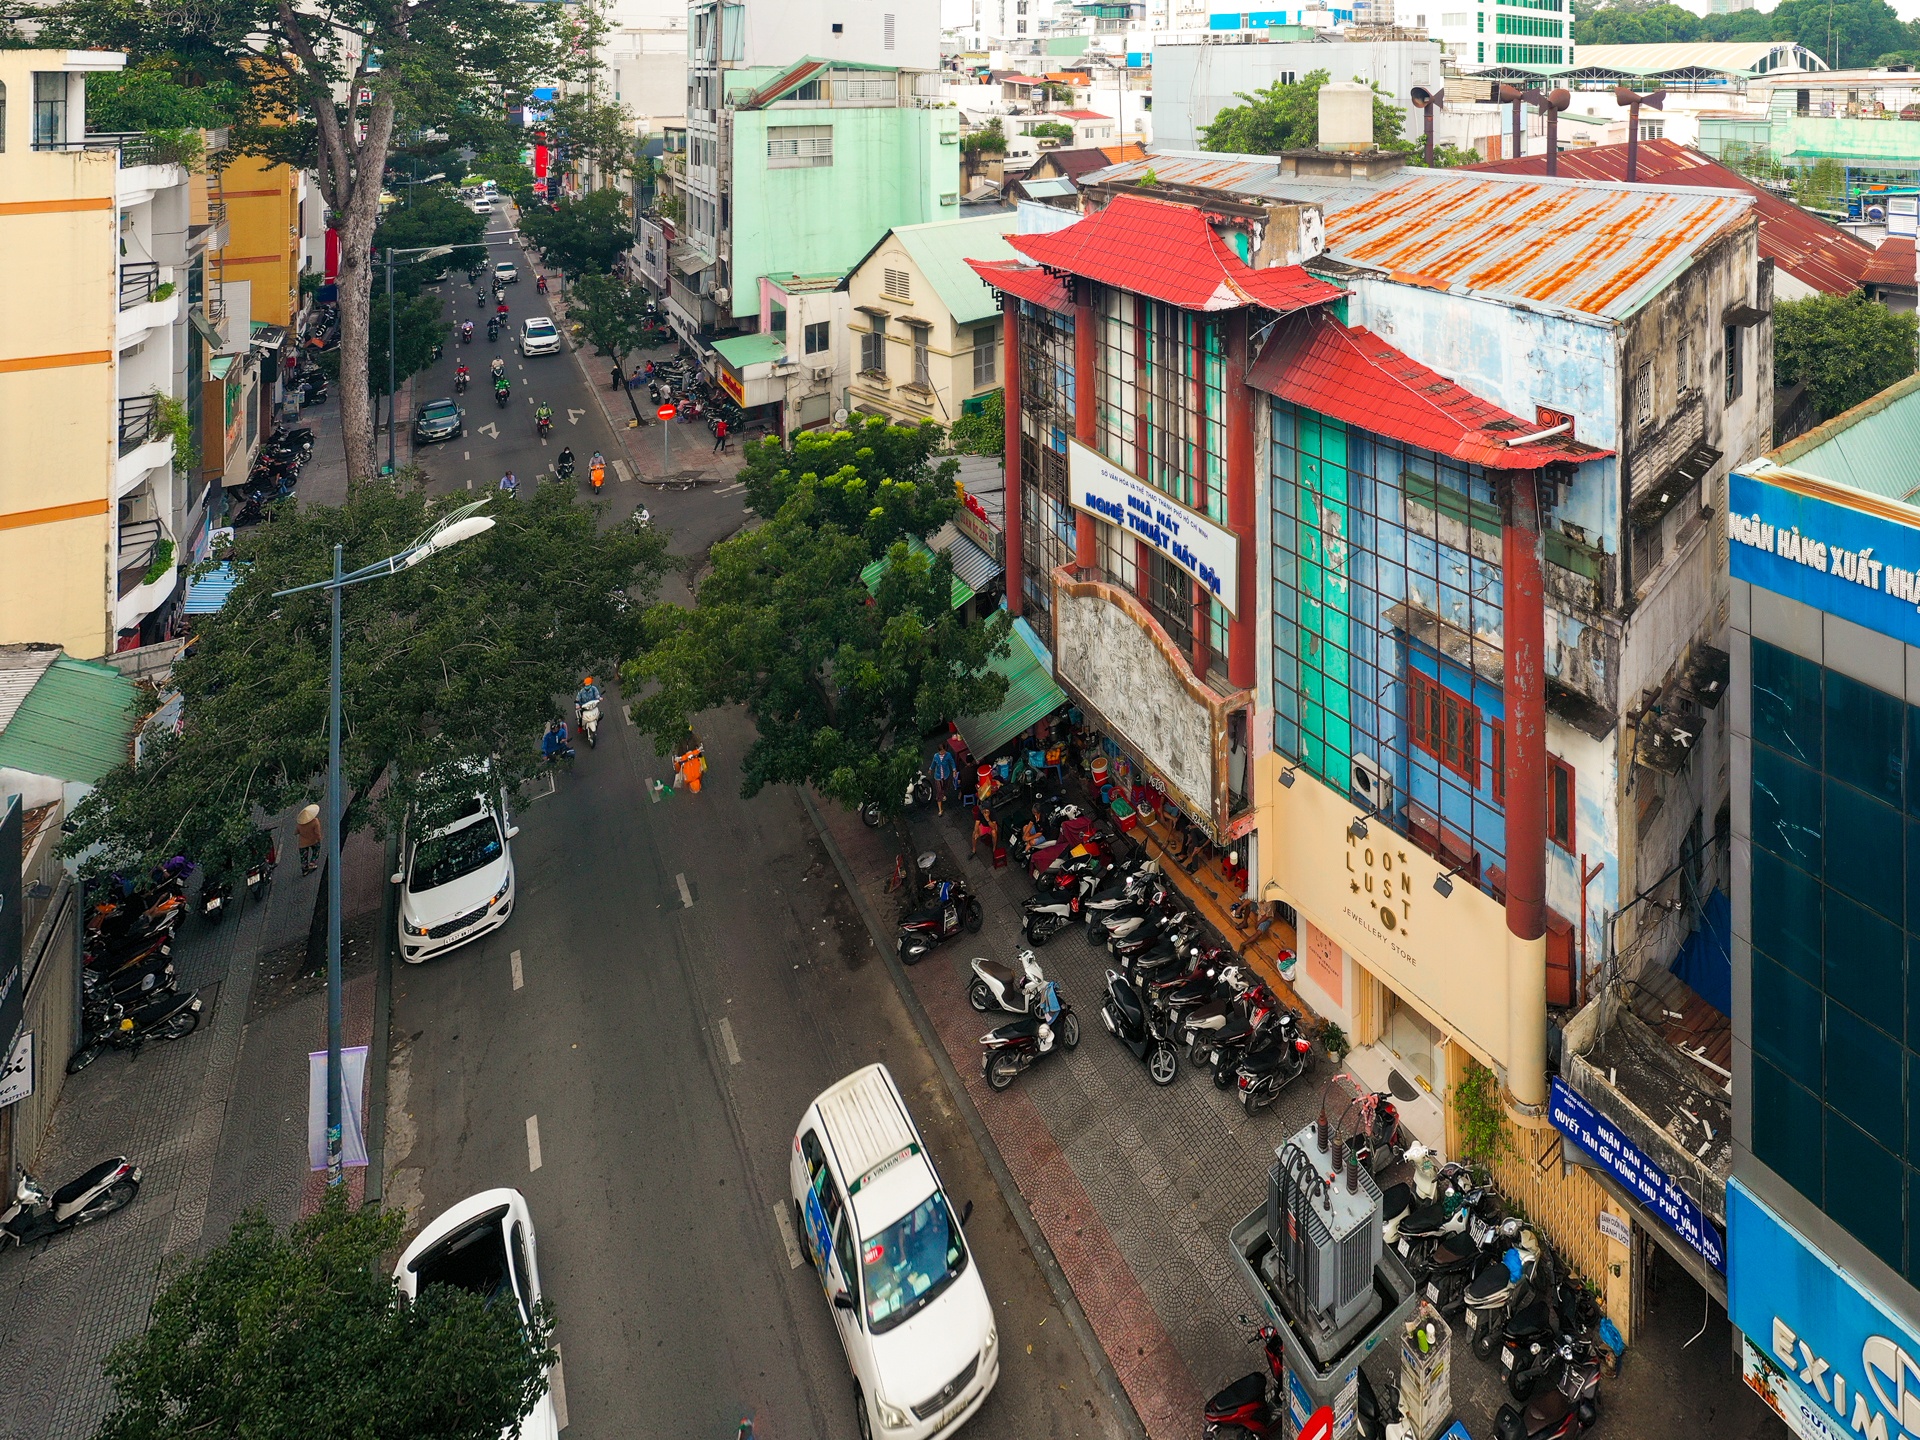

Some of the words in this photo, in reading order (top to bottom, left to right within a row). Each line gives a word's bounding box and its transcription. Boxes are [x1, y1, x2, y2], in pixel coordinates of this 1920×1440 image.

[1085, 492, 1124, 525] NGHỆ
[1127, 511, 1170, 550] THUẬT
[1172, 539, 1198, 572] HÁT
[1199, 561, 1221, 595] BỘI
[1127, 494, 1153, 519] NHÀ
[1156, 510, 1180, 536] HÁT
[1728, 511, 1775, 554] NGÂN
[1777, 525, 1828, 573] HÀNG
[1830, 547, 1883, 591] XUẤT
[1346, 851, 1411, 920] LUST
[1342, 906, 1388, 944] JEWELLERY
[1390, 942, 1417, 967] STORE
[1554, 1107, 1580, 1135] QUYẾT
[1582, 1129, 1598, 1152] TÂM
[1614, 1158, 1636, 1185] VỮNG
[1638, 1179, 1657, 1201] KHU
[1659, 1196, 1678, 1221] PHỐ
[1681, 1214, 1698, 1239] VĂN
[1702, 1236, 1722, 1262] HÓA
[1598, 1125, 1620, 1151] NHÂN
[1623, 1145, 1641, 1168] DÂN
[1644, 1164, 1661, 1187] KHU
[1665, 1182, 1682, 1206] PHỐ
[1684, 1203, 1691, 1215] 4
[1675, 1223, 1685, 1236] TỔ
[1686, 1233, 1702, 1252] DÂN
[1702, 1249, 1718, 1266] PHỐ
